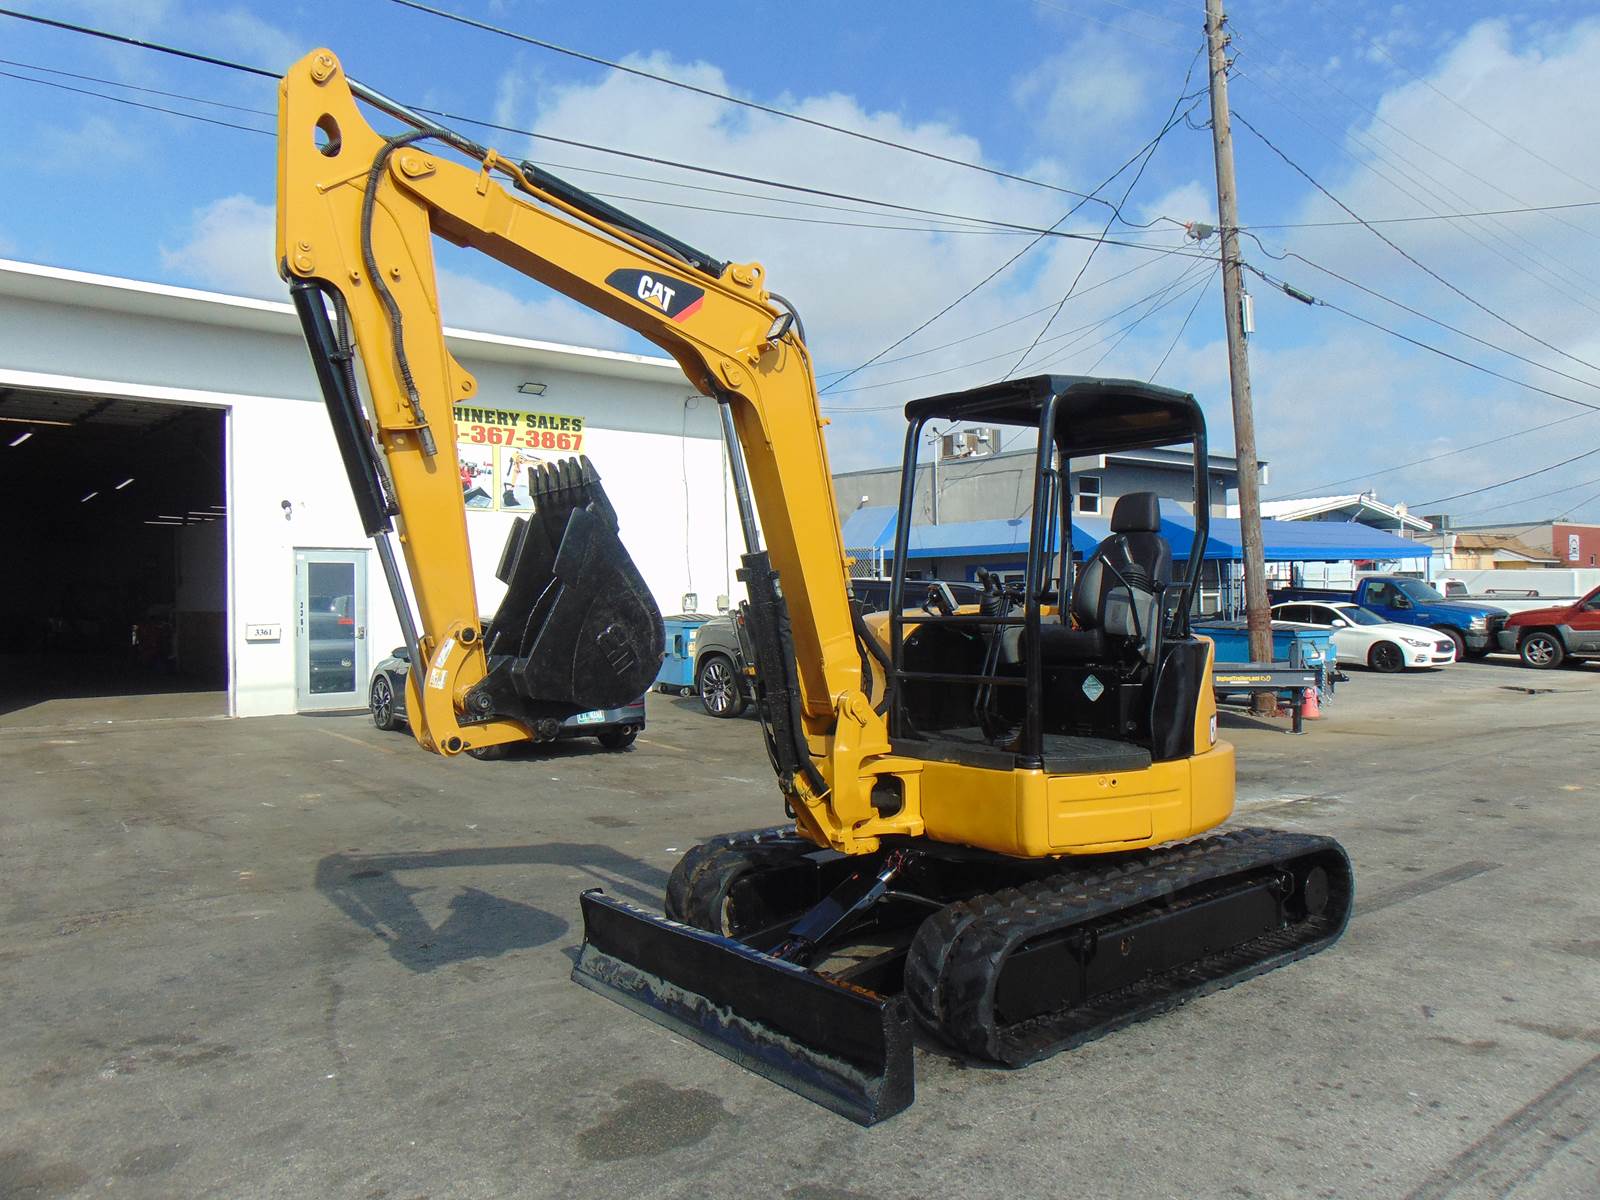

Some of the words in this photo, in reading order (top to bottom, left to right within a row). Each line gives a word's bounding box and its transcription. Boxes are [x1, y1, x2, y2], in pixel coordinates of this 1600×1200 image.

[637, 274, 676, 313] CAT
[526, 414, 582, 432] SALES
[254, 628, 272, 637] 3361
